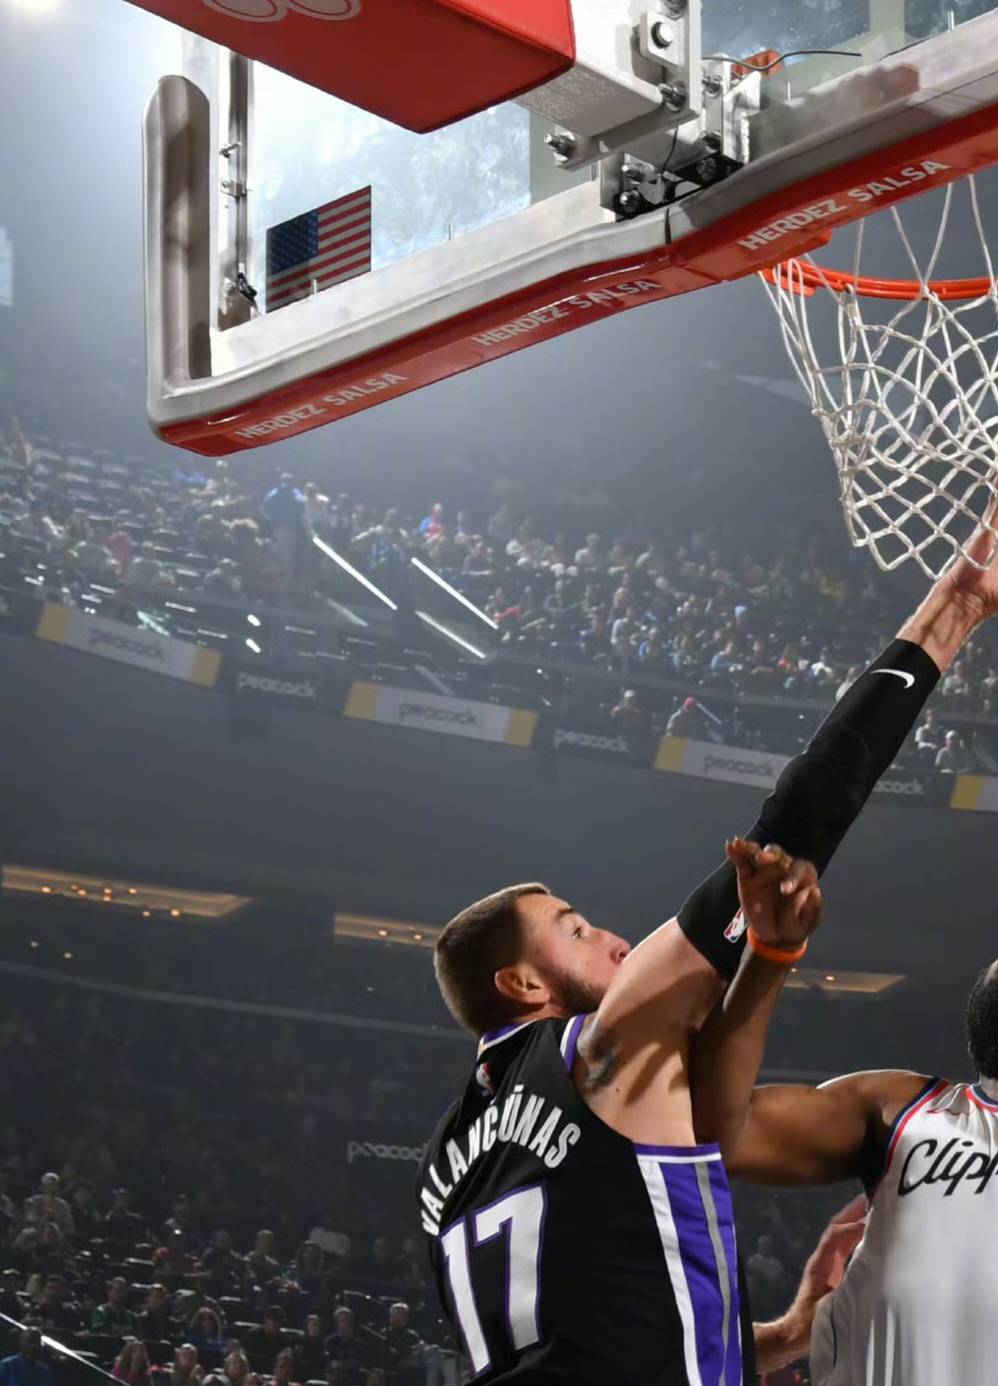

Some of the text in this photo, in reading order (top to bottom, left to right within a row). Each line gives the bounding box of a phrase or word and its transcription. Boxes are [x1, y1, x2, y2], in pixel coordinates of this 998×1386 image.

[737, 160, 950, 250] HERDEZ SALSA
[472, 280, 661, 346] HERDEZ SALSA
[234, 372, 408, 439] HERDEZ SALSA
[237, 672, 316, 698] peacock
[554, 729, 630, 753] peacock
[872, 777, 925, 796] acock
[439, 1181, 548, 1377] 17
